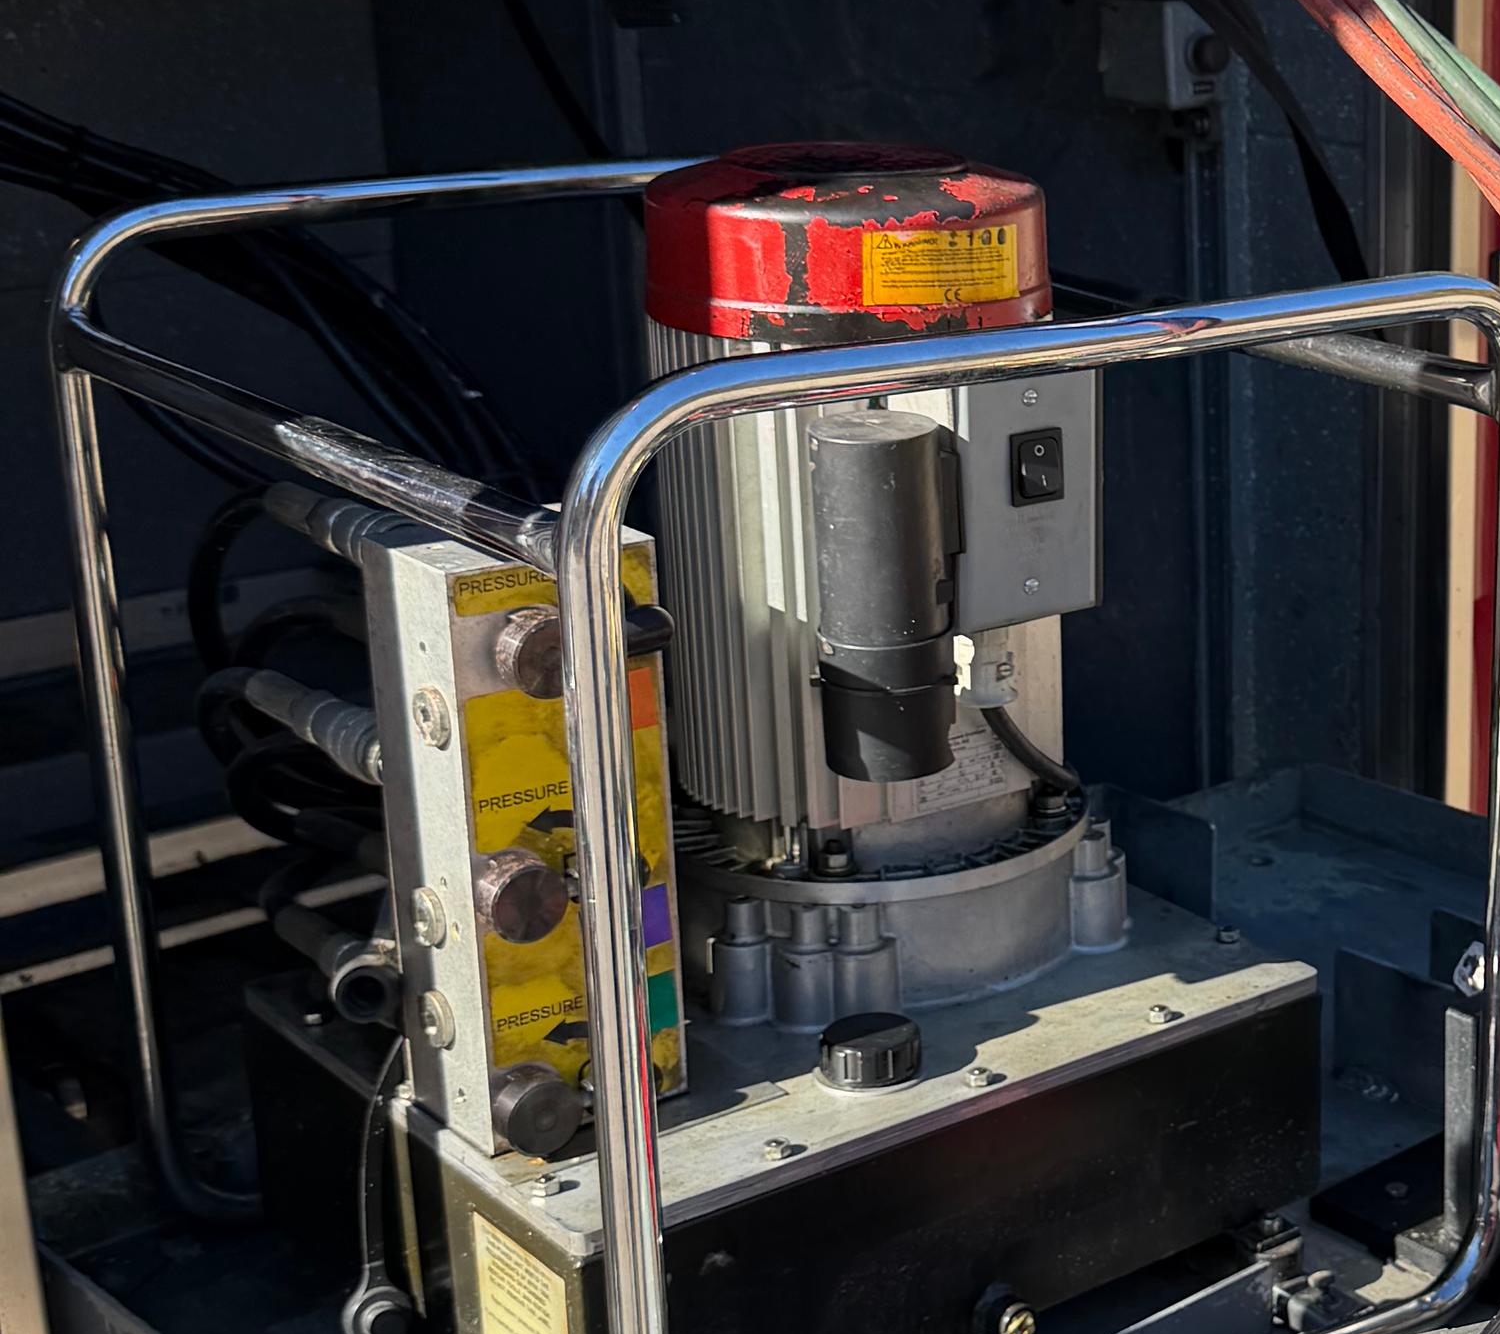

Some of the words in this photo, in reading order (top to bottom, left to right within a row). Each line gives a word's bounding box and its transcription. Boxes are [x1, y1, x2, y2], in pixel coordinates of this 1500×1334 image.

[944, 288, 963, 302] CE
[479, 780, 569, 814] PRESSURE
[496, 995, 584, 1033] PRESSURE
